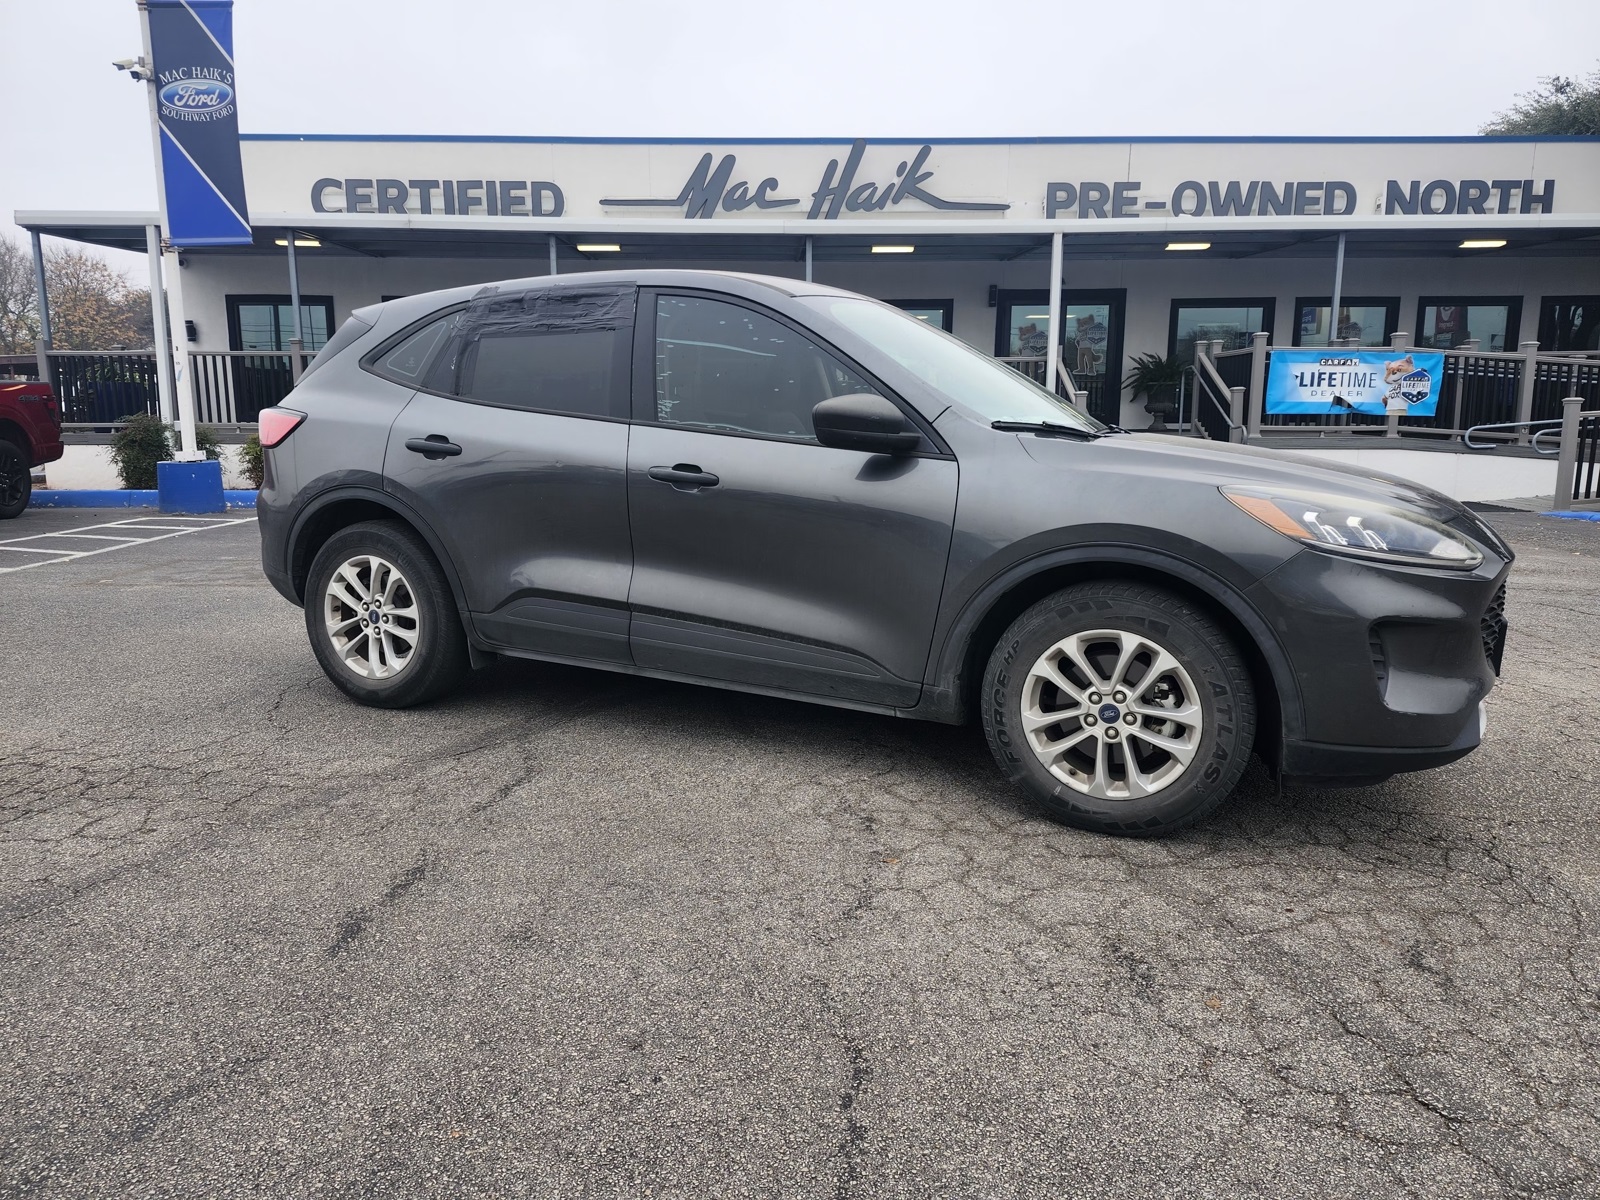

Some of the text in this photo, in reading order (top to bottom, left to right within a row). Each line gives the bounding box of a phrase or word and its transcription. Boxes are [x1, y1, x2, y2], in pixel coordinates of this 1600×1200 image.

[158, 66, 234, 85] MAC HAIK'S
[174, 84, 220, 106] Ford
[161, 104, 234, 121] SOUTHWAY FORD
[310, 138, 1556, 219] CERTIFIED Mac Haik PRE-OWNED NORTH
[1319, 358, 1360, 367] CARFAX
[1299, 372, 1377, 388] LIFETIME
[993, 639, 1022, 764] FORCE HP
[1203, 680, 1234, 784] ATLAS
